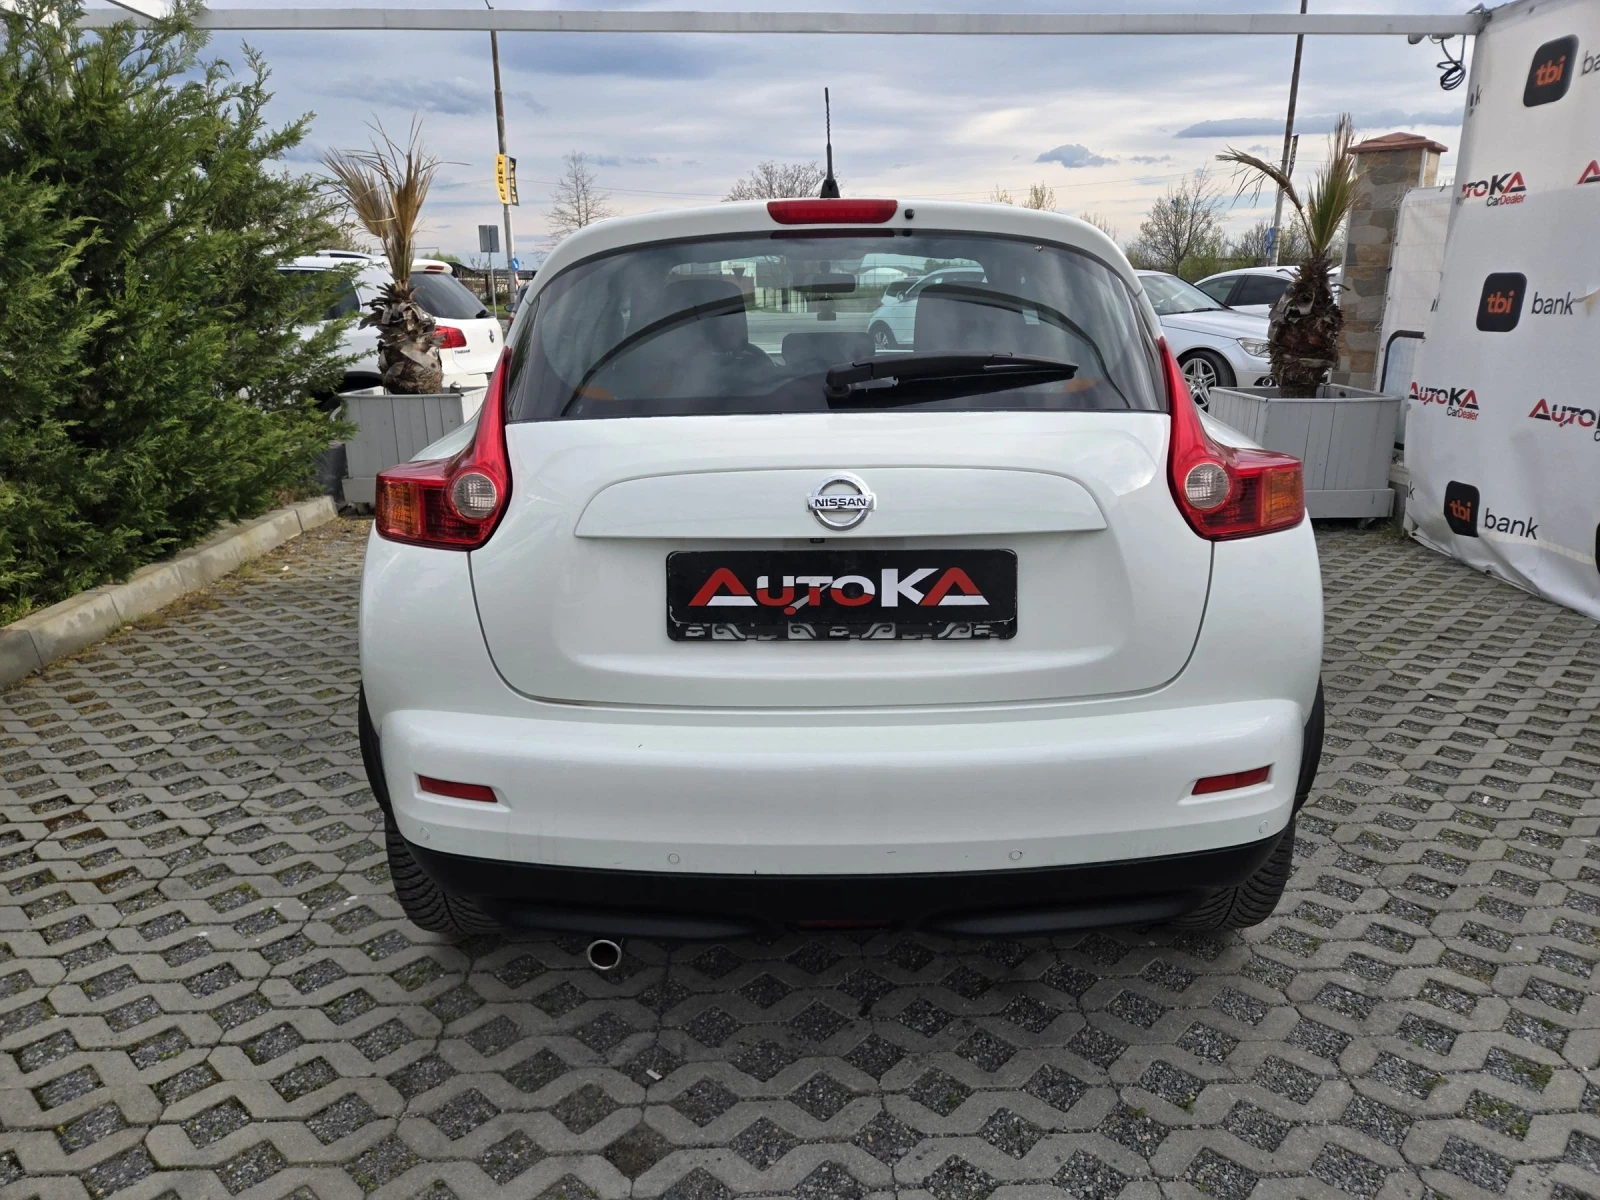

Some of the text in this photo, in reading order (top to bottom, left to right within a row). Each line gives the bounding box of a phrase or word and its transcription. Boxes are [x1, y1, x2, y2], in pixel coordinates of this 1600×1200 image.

[1536, 55, 1566, 87] tbi
[498, 157, 506, 201] EFBET
[1486, 193, 1526, 207] CarDealer
[1487, 289, 1575, 315] tbi bank
[1447, 406, 1479, 421] CarDealer
[1528, 398, 1600, 429] AUTO
[814, 497, 867, 508] NISSAN
[1450, 500, 1539, 540] tbi bank
